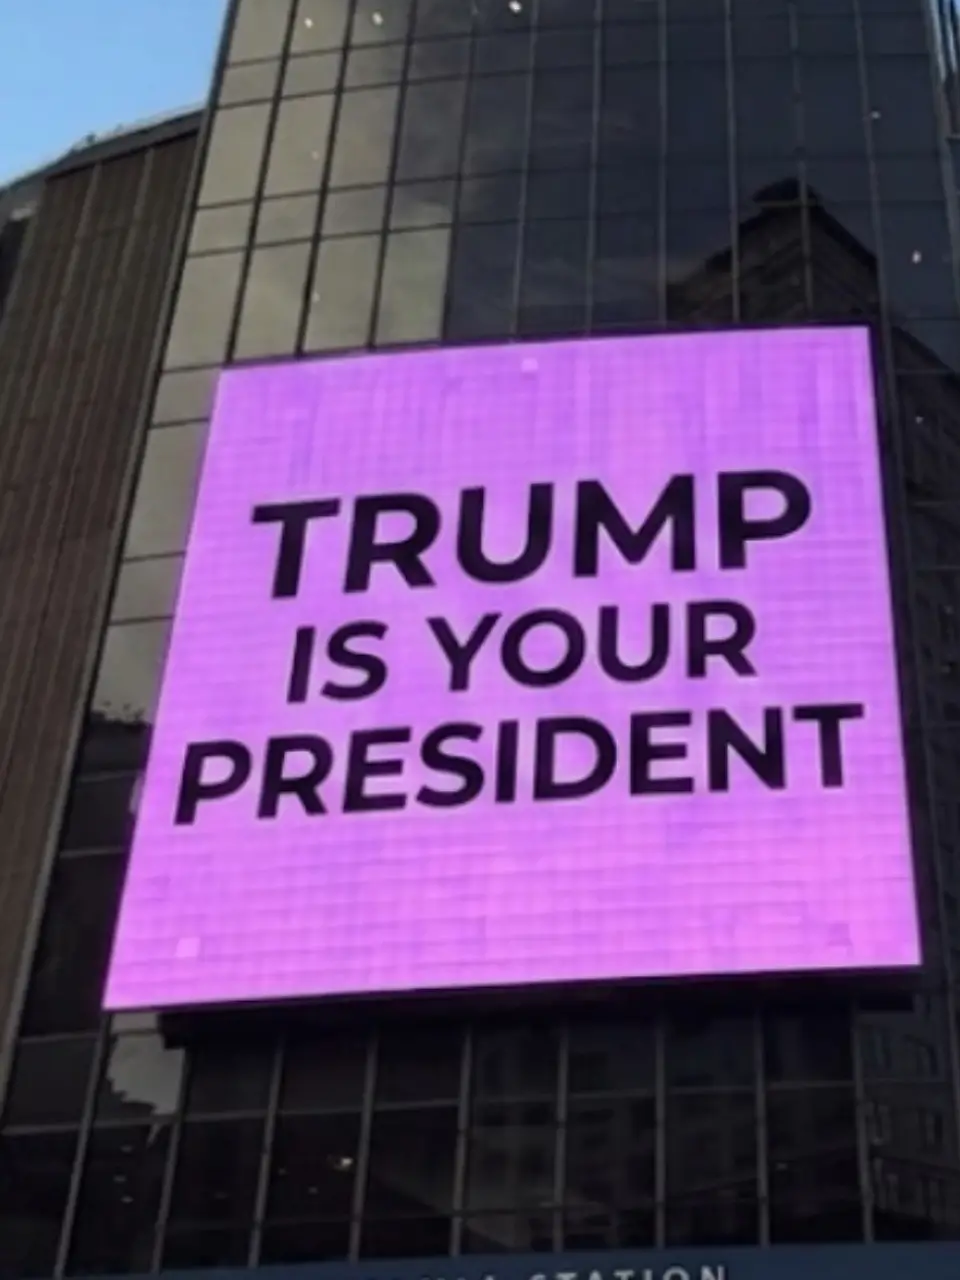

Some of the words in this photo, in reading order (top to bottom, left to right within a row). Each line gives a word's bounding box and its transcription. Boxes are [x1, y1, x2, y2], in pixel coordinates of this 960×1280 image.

[252, 469, 812, 599] TRUMP
[286, 620, 388, 704] IS
[428, 600, 757, 692] YOUR
[173, 703, 864, 826] PRESIDENT
